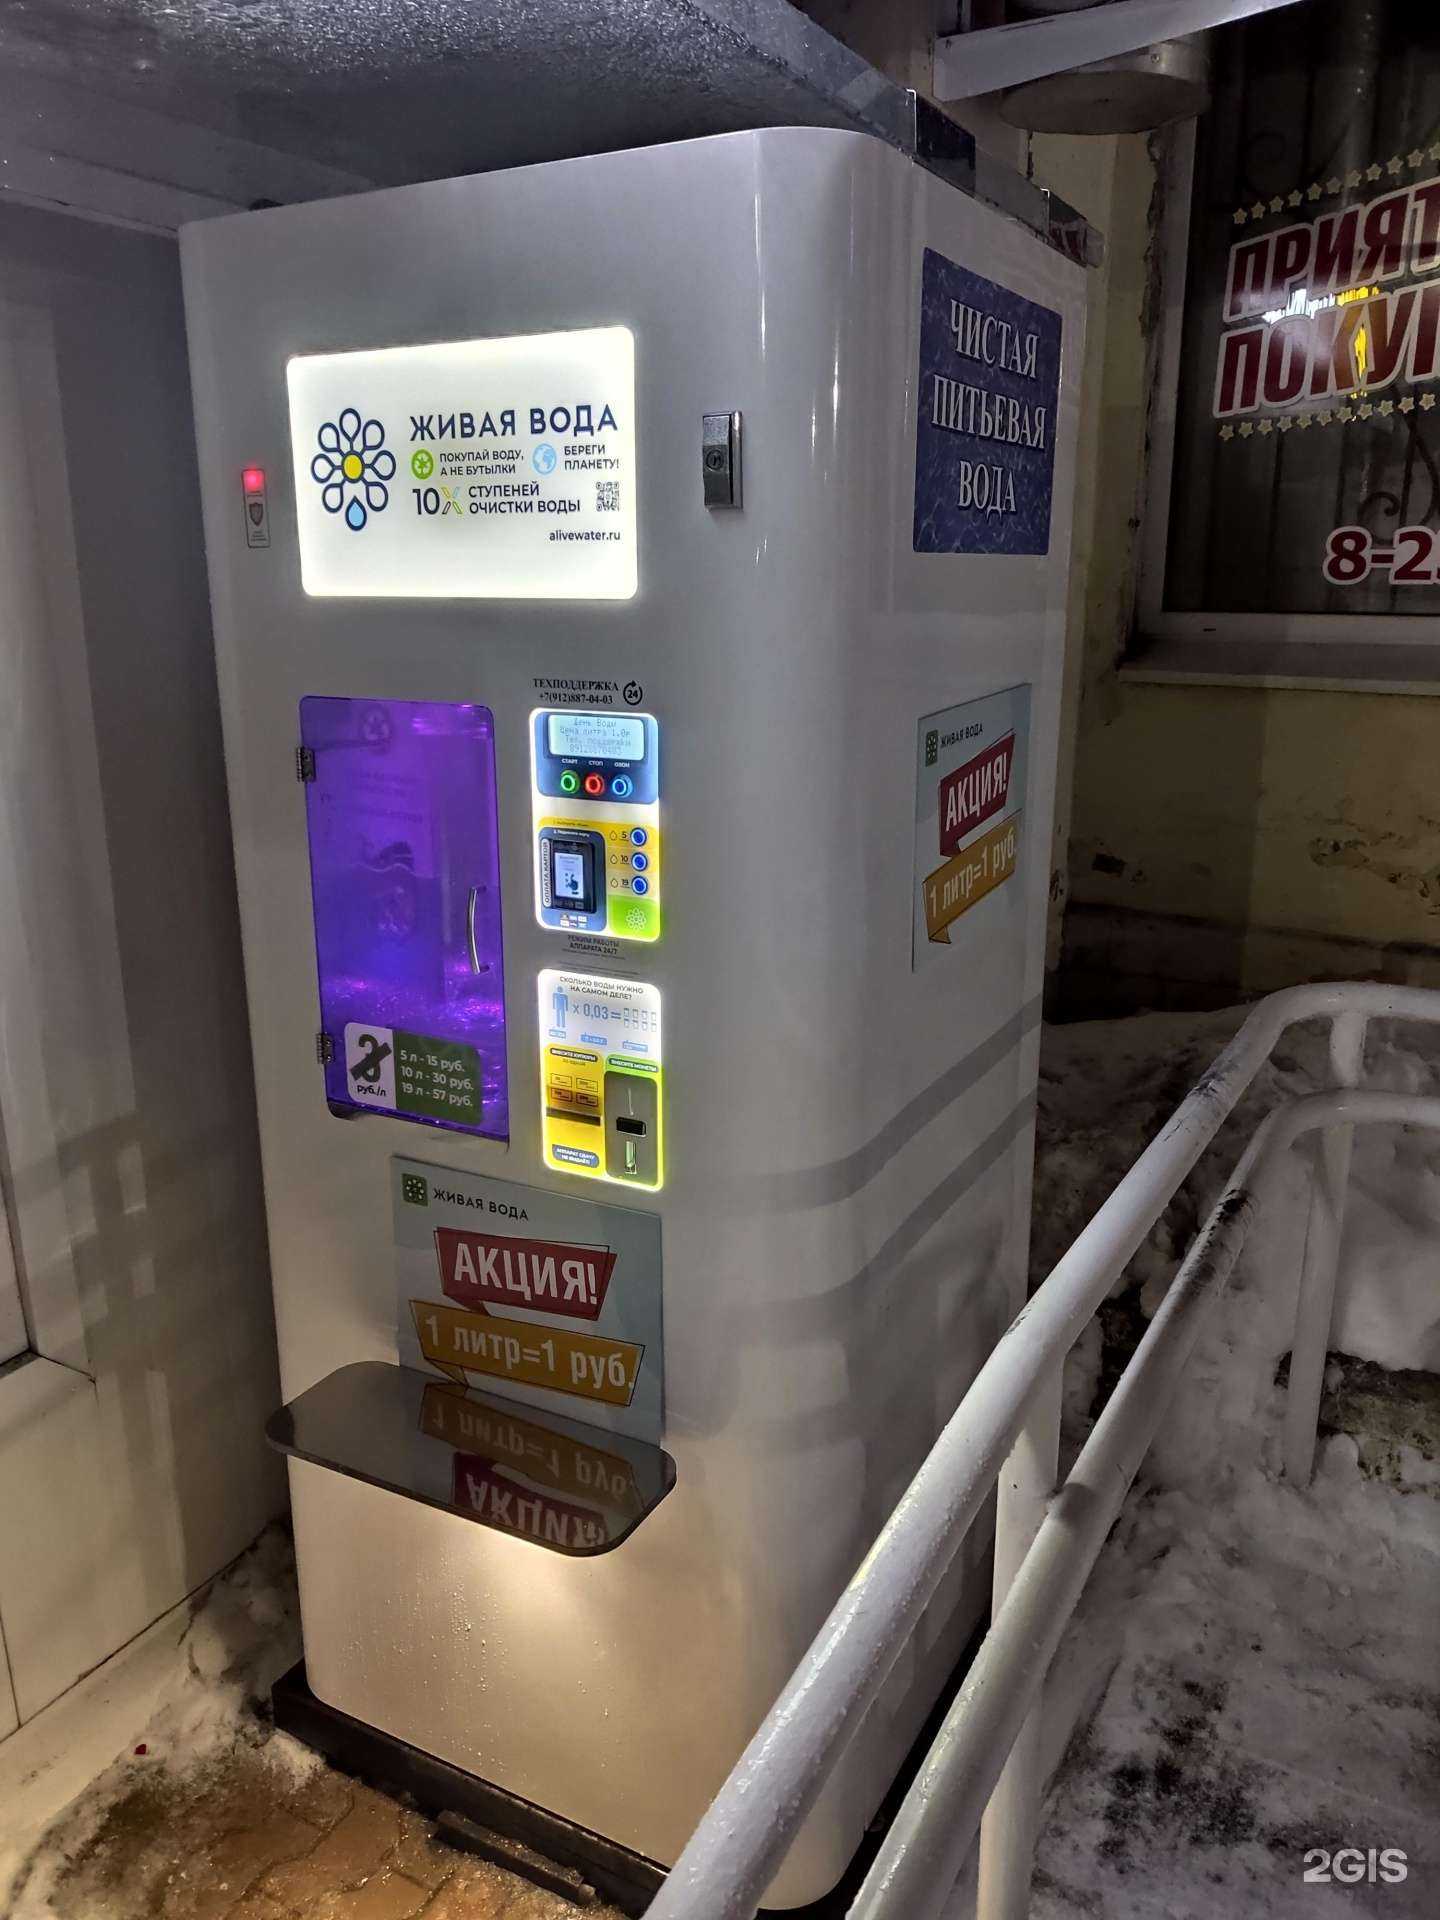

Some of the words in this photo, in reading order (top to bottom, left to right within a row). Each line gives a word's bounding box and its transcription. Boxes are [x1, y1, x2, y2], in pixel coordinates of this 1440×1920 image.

[950, 299, 1039, 379] ЧИСТАЯ
[931, 374, 1047, 449] ПИТЬЕВАЯ
[409, 409, 516, 441] ЖИВАЯ
[529, 404, 618, 437] ВОДА
[440, 448, 489, 463] ПОКУПАЙ
[492, 449, 524, 462] ВОДУ,
[564, 444, 606, 456] БЕРЕГИ
[440, 467, 447, 476] А
[450, 466, 464, 476] НЕ
[466, 464, 516, 475] БУТЫЛКИ
[564, 458, 619, 470] ПЛАНЕТУ!
[468, 481, 540, 498] СТУПЕНЕЙ
[957, 460, 1017, 521] ВОДА
[469, 501, 533, 514] ОЧИСТКИ
[537, 500, 580, 515] ВОДЫ
[549, 529, 620, 542] alivewater.ru
[1323, 526, 1440, 585] 8-2
[627, 689, 638, 699] 24
[940, 732, 964, 749] ЖИВАЯ
[965, 723, 984, 740] ВОДА
[945, 752, 1008, 831] АКЦИЯ!
[621, 831, 627, 839] 5
[620, 855, 629, 863] 10
[929, 885, 938, 918] 1
[942, 847, 988, 911] литр=1
[569, 942, 602, 953] АППАРАТА
[560, 976, 592, 987] СКОЛЬКО
[594, 981, 615, 991] ВОДЫ
[616, 984, 644, 994] НУЖНО
[582, 987, 608, 996] САМОМ
[609, 991, 632, 1001] ДЕЛЕ?
[583, 1003, 608, 1020] 0,03
[400, 1050, 408, 1061] 5
[409, 1054, 417, 1063] л
[426, 1054, 438, 1066] 15
[440, 1060, 465, 1072] руб.
[401, 1066, 413, 1077] 10
[415, 1071, 423, 1080] л
[432, 1073, 447, 1085] 30
[449, 1078, 474, 1091] руб.
[357, 1084, 387, 1097] руб./л
[401, 1082, 413, 1094] 19
[415, 1087, 423, 1096] л
[432, 1088, 446, 1100] 57
[448, 1094, 473, 1107] руб.
[433, 1187, 484, 1210] ЖИВАЯ
[488, 1200, 529, 1221] ВОДА
[453, 1242, 598, 1305] АКЦИЯ!
[425, 1315, 440, 1347] 1
[452, 1327, 556, 1371] литр=1
[570, 1351, 635, 1391] руб.
